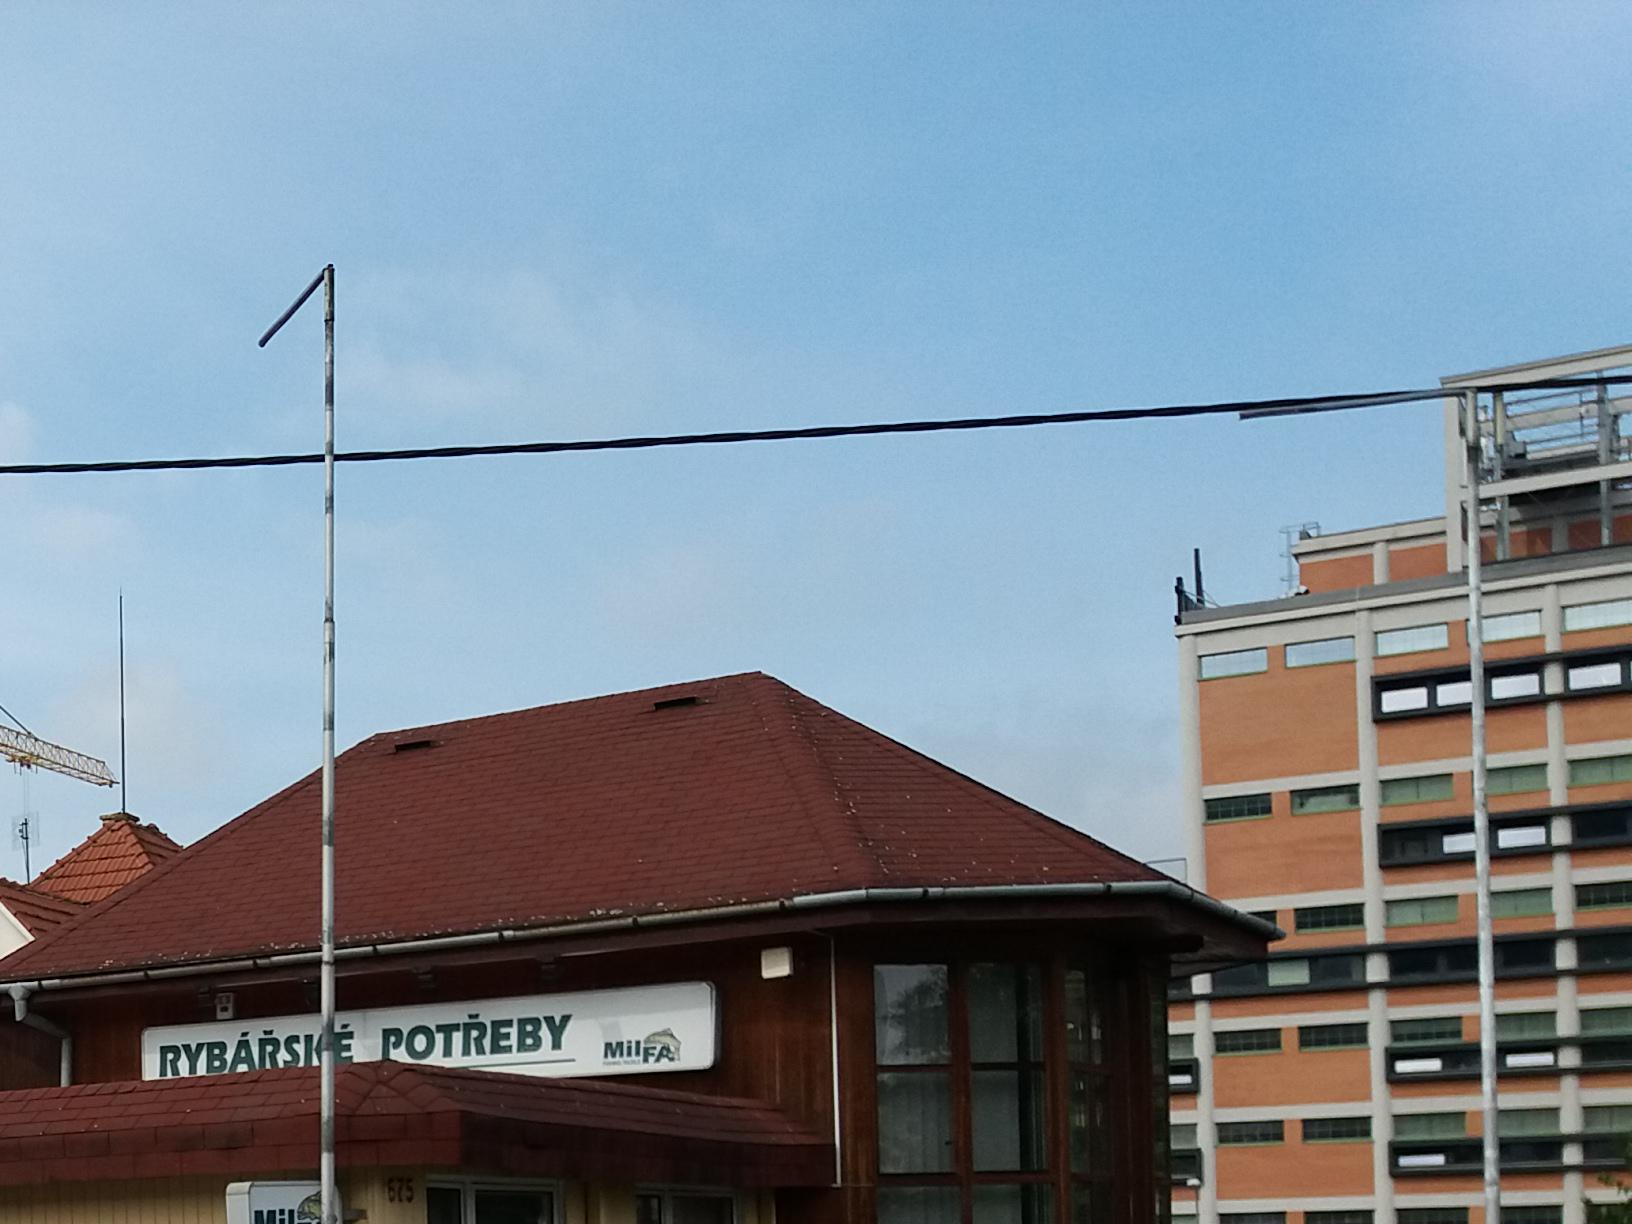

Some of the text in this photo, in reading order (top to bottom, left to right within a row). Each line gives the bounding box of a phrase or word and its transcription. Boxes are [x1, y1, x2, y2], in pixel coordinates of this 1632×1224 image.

[158, 1013, 573, 1078] RYBÁŘSKÉ POTŘEBY
[387, 1177, 414, 1203] 675
